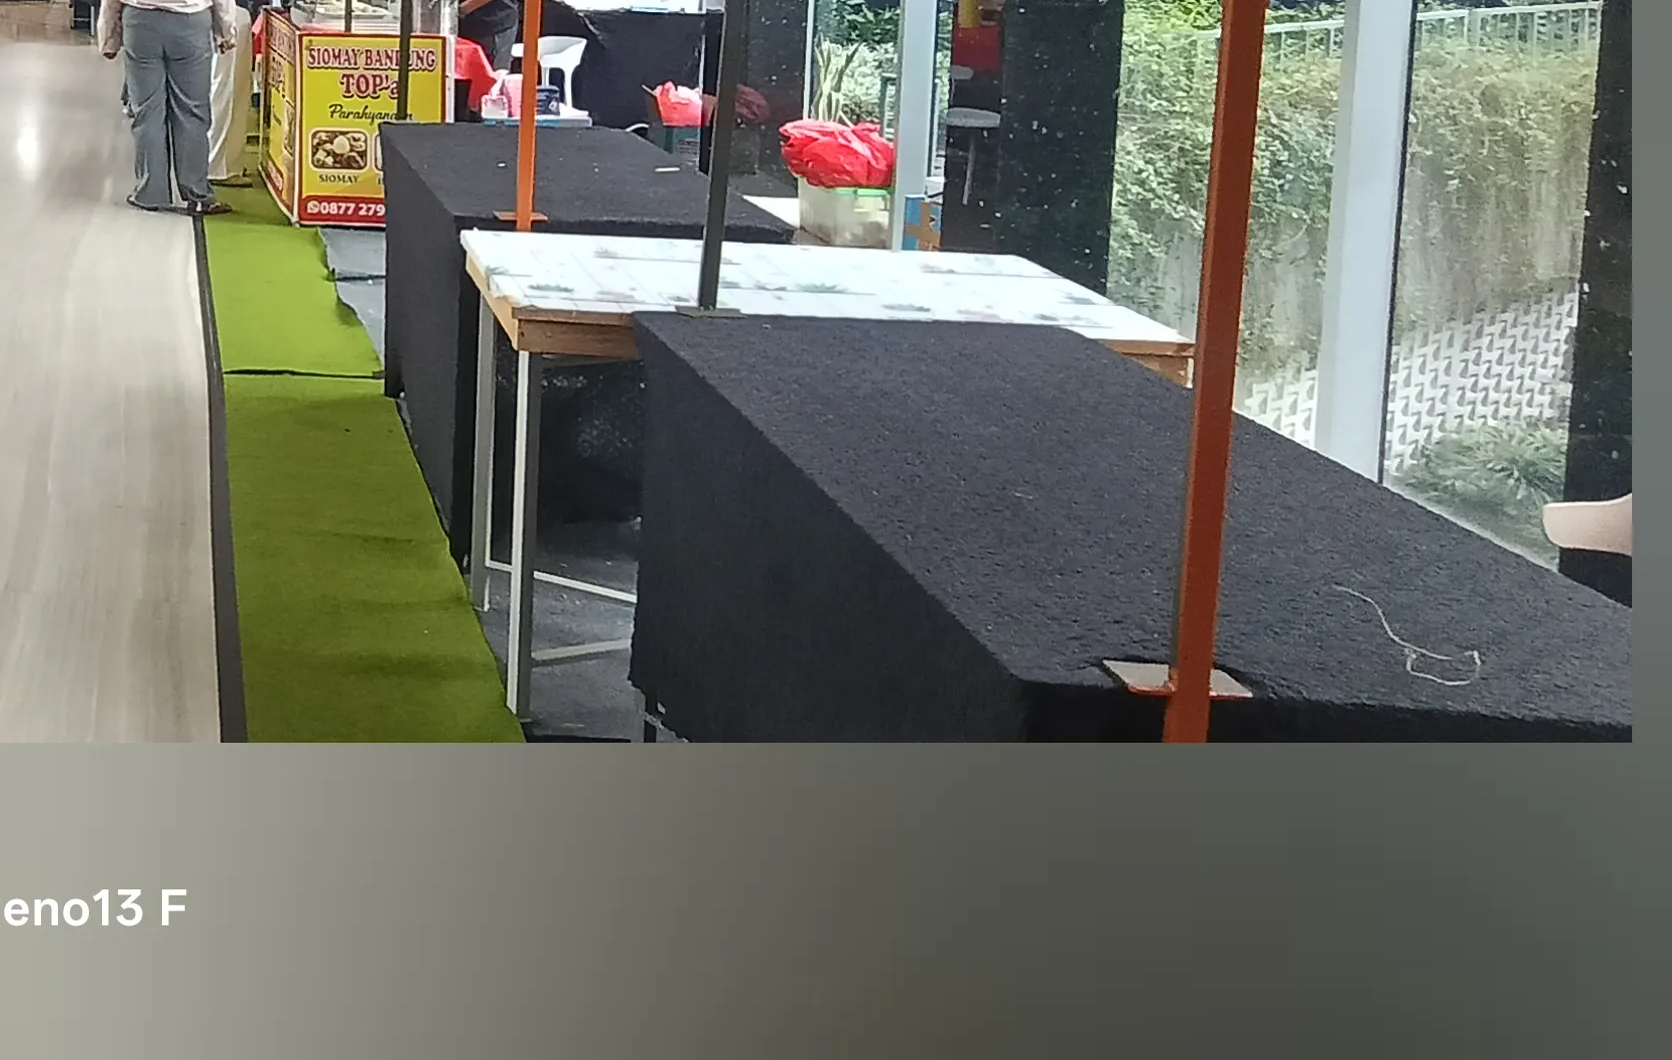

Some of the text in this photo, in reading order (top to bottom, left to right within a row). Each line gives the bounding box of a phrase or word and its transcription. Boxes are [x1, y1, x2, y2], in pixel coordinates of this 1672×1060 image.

[308, 47, 436, 69] SIOMAY BANUNG
[329, 103, 414, 126] Parahyann
[319, 174, 359, 184] SIOMAY
[320, 201, 386, 217] 0877 279
